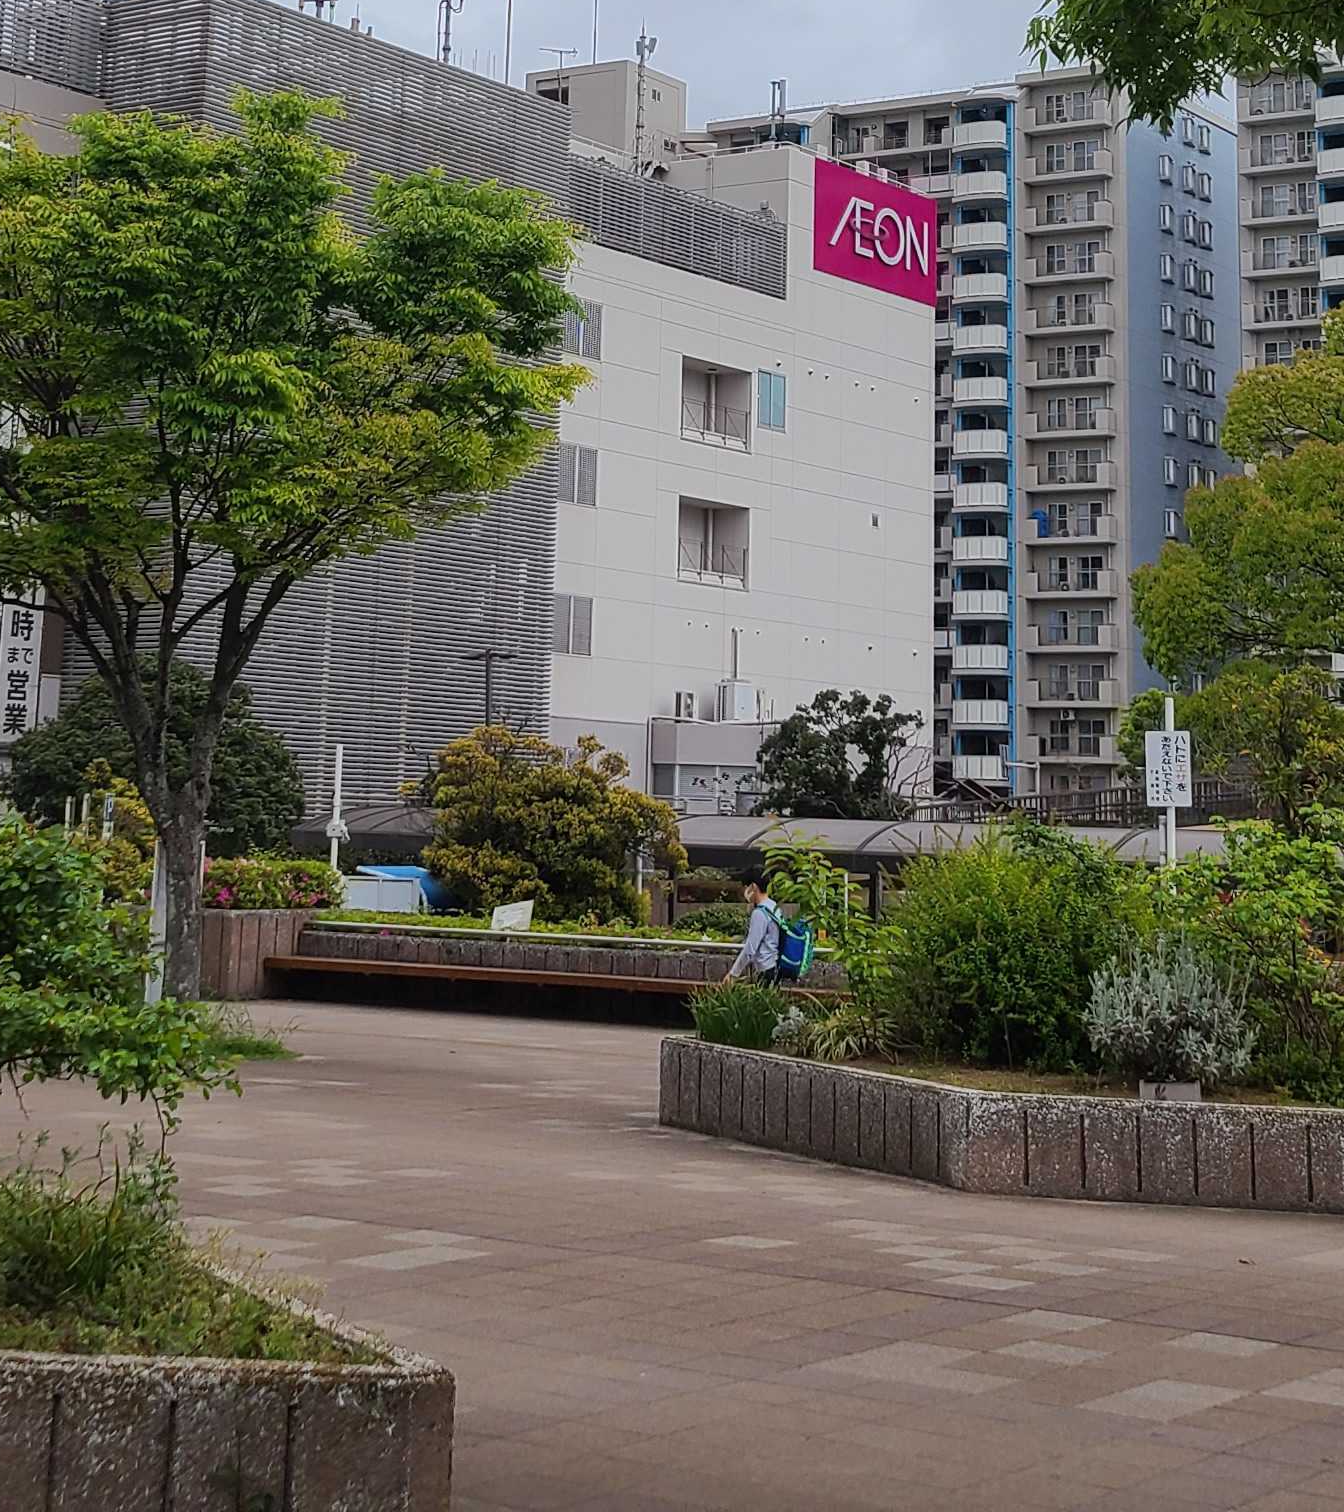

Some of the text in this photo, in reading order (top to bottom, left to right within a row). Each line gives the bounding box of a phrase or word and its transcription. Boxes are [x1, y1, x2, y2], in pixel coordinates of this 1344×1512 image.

[1175, 735, 1187, 792] ハトにエサを
